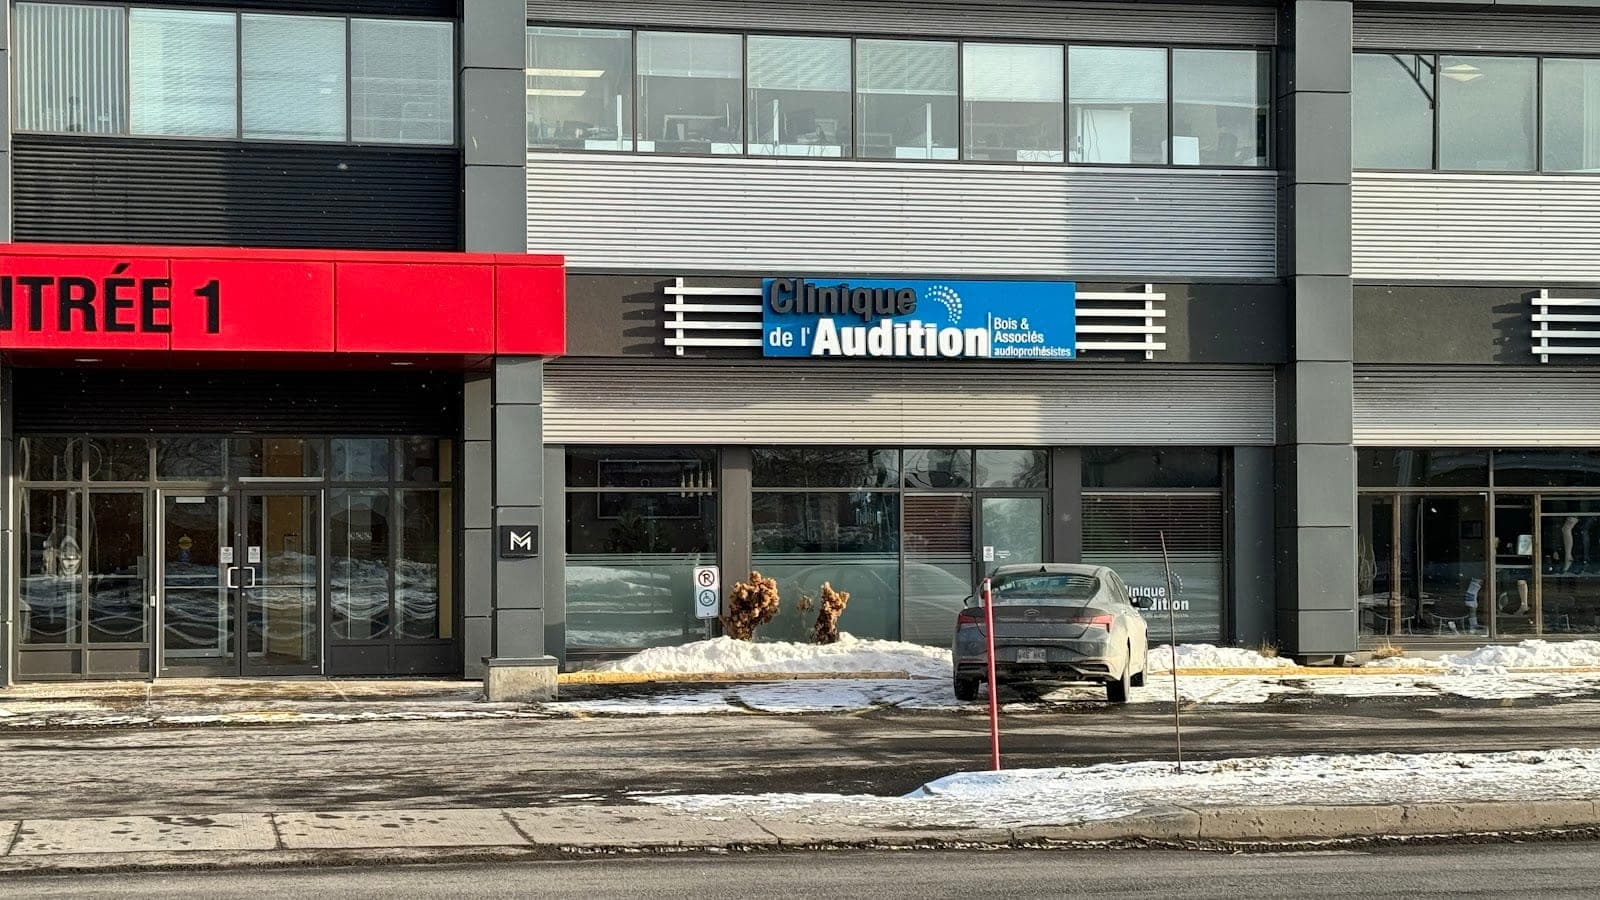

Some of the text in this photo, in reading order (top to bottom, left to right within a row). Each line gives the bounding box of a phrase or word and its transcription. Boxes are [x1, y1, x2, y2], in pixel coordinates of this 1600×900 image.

[194, 279, 220, 334] 1
[770, 277, 918, 322] Clinique
[994, 317, 1030, 330] Bois &
[769, 327, 793, 347] de
[994, 330, 1044, 343] Associés
[994, 345, 1071, 358] audioprothésistes
